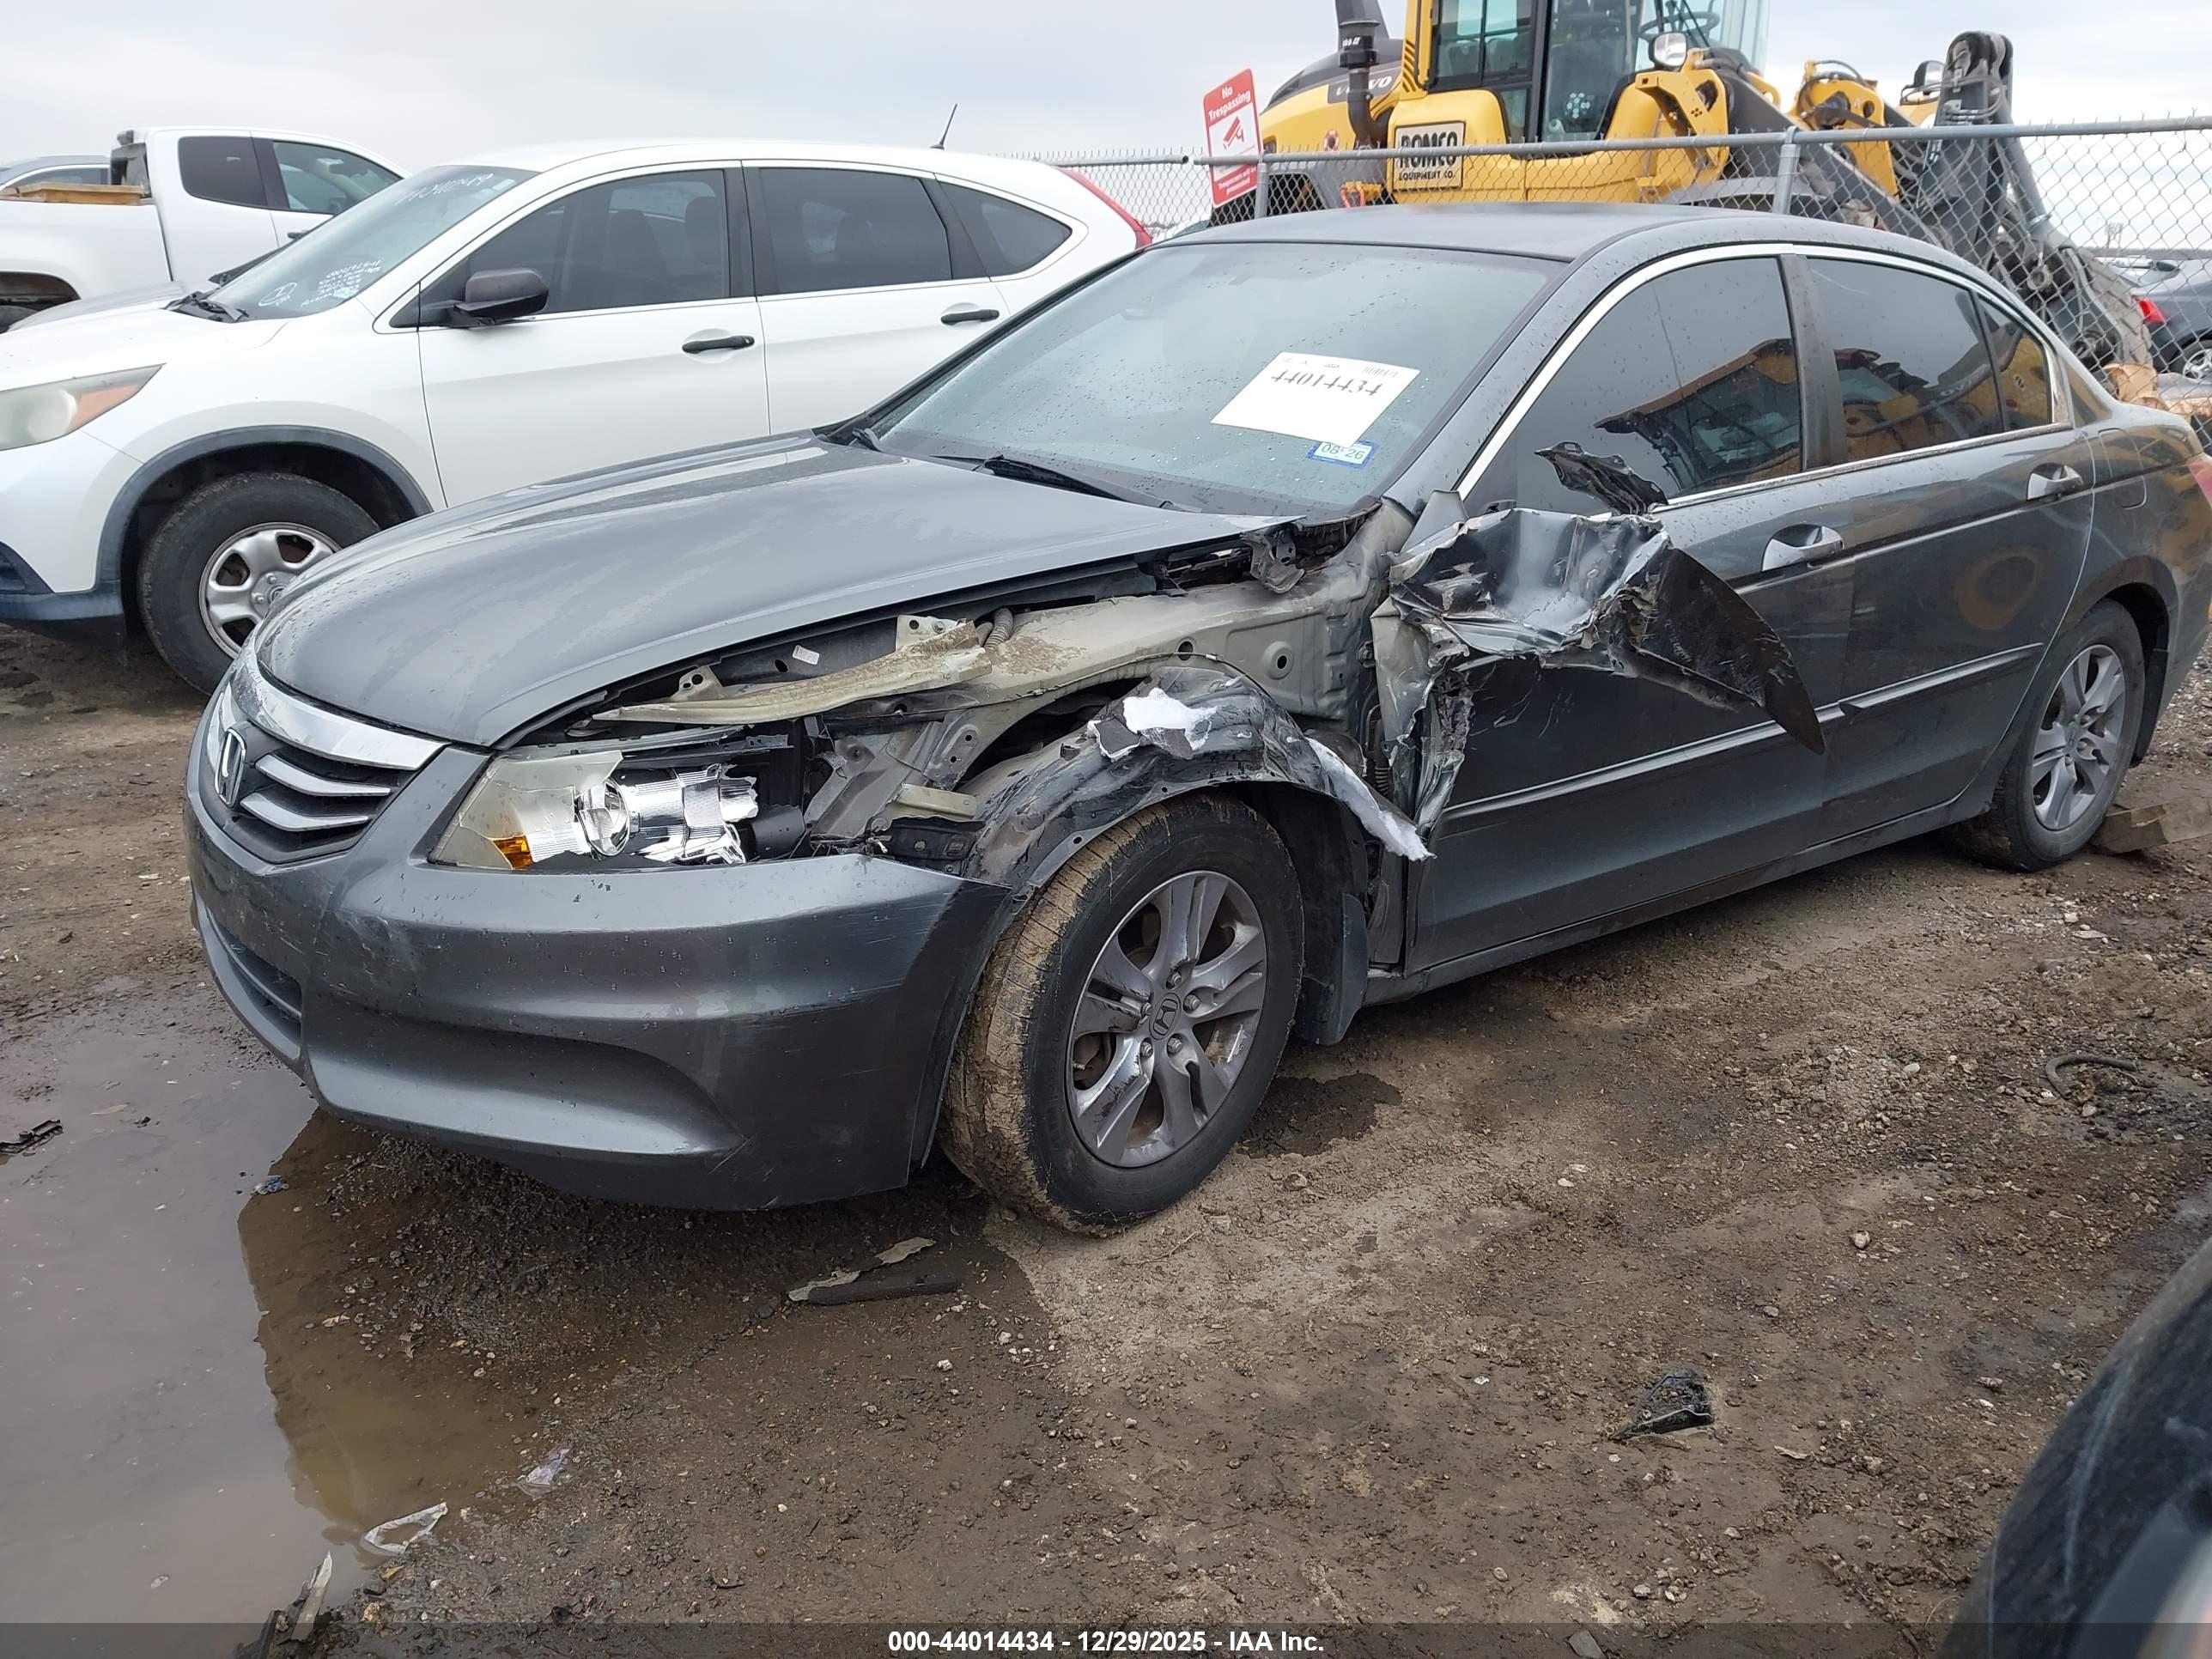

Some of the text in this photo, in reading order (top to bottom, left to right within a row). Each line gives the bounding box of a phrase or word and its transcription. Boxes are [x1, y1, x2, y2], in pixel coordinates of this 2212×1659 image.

[1222, 87, 1234, 100] No
[1335, 76, 1392, 95] VVO
[1208, 90, 1251, 121] Trespassing
[1400, 131, 1458, 169] ROMCO
[1270, 370, 1383, 397] 44014434
[1345, 448, 1365, 459] 26
